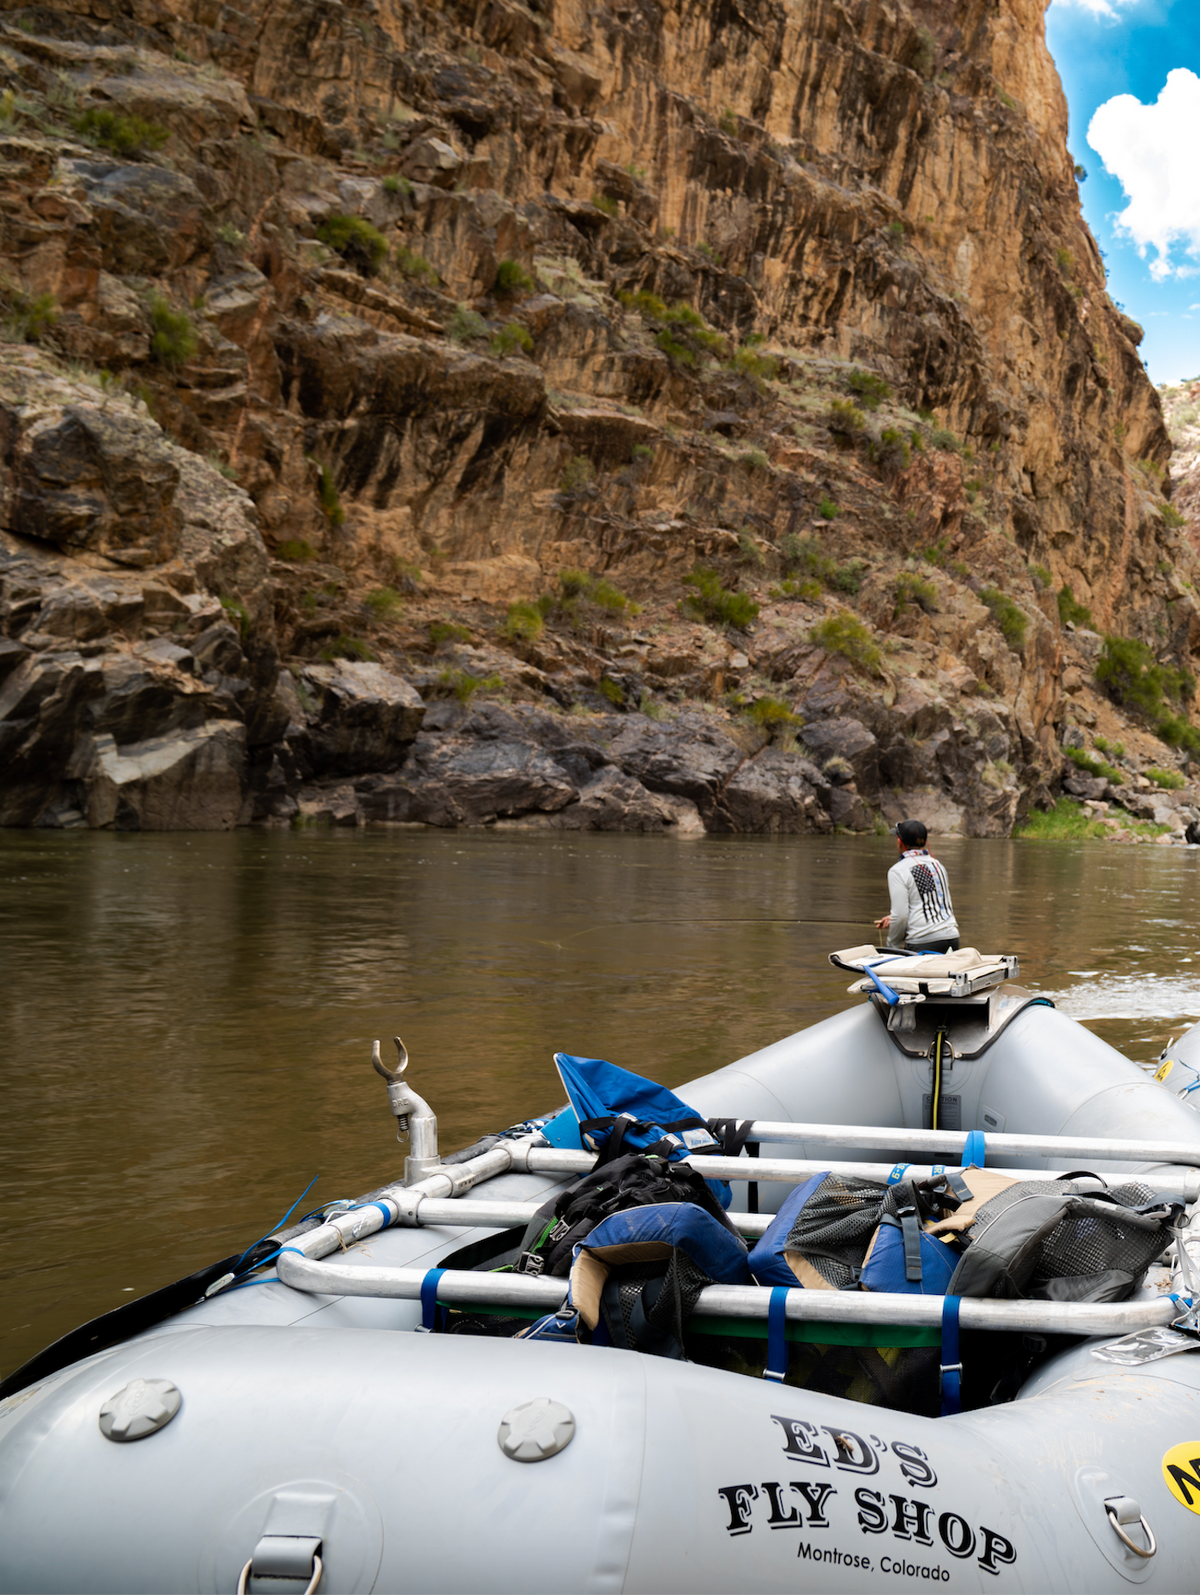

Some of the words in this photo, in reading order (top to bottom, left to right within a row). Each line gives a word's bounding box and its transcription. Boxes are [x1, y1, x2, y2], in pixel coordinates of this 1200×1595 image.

[770, 1414, 938, 1488] ED'S
[718, 1481, 838, 1537] FLY
[854, 1487, 1017, 1576] SHOP
[797, 1541, 875, 1572] Montrose,
[880, 1557, 950, 1582] Colorado
